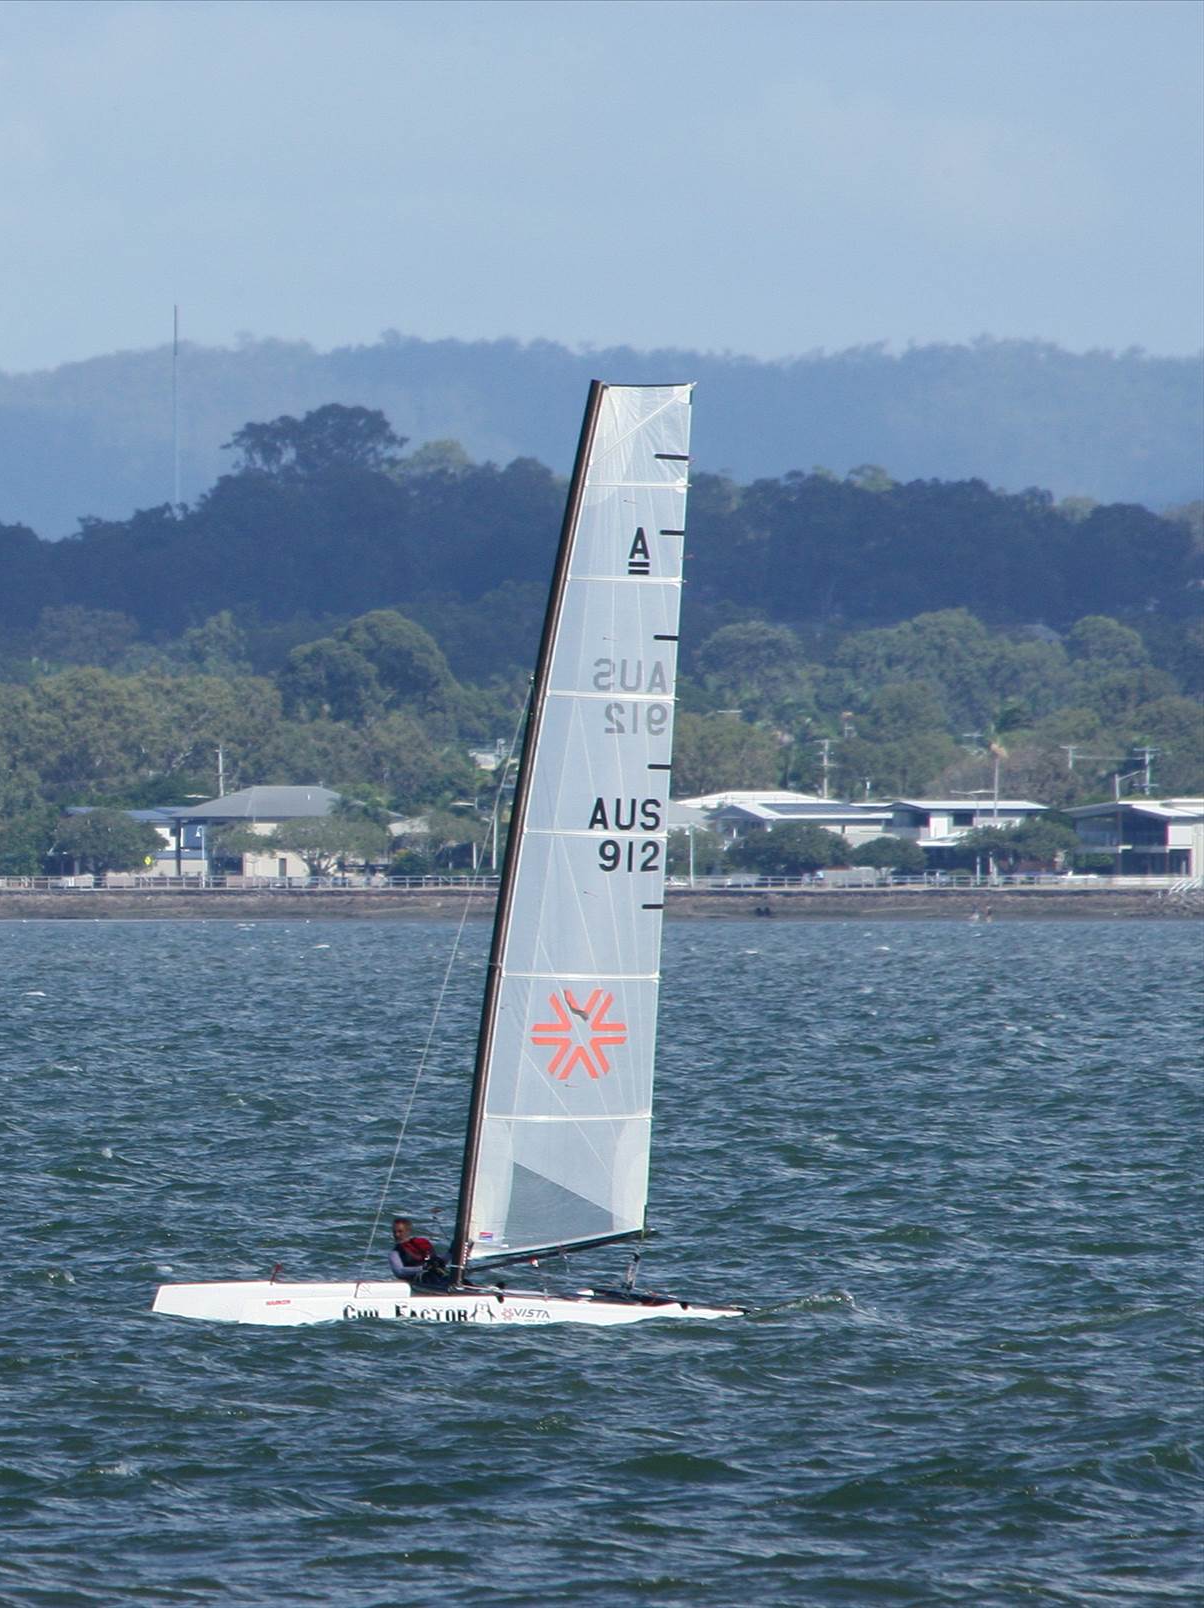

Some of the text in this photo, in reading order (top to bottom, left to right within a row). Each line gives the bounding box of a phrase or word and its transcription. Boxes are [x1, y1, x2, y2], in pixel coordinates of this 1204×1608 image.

[629, 527, 651, 560] A
[588, 797, 661, 831] AUS
[598, 840, 659, 873] 912
[513, 1308, 550, 1319] VISTA
